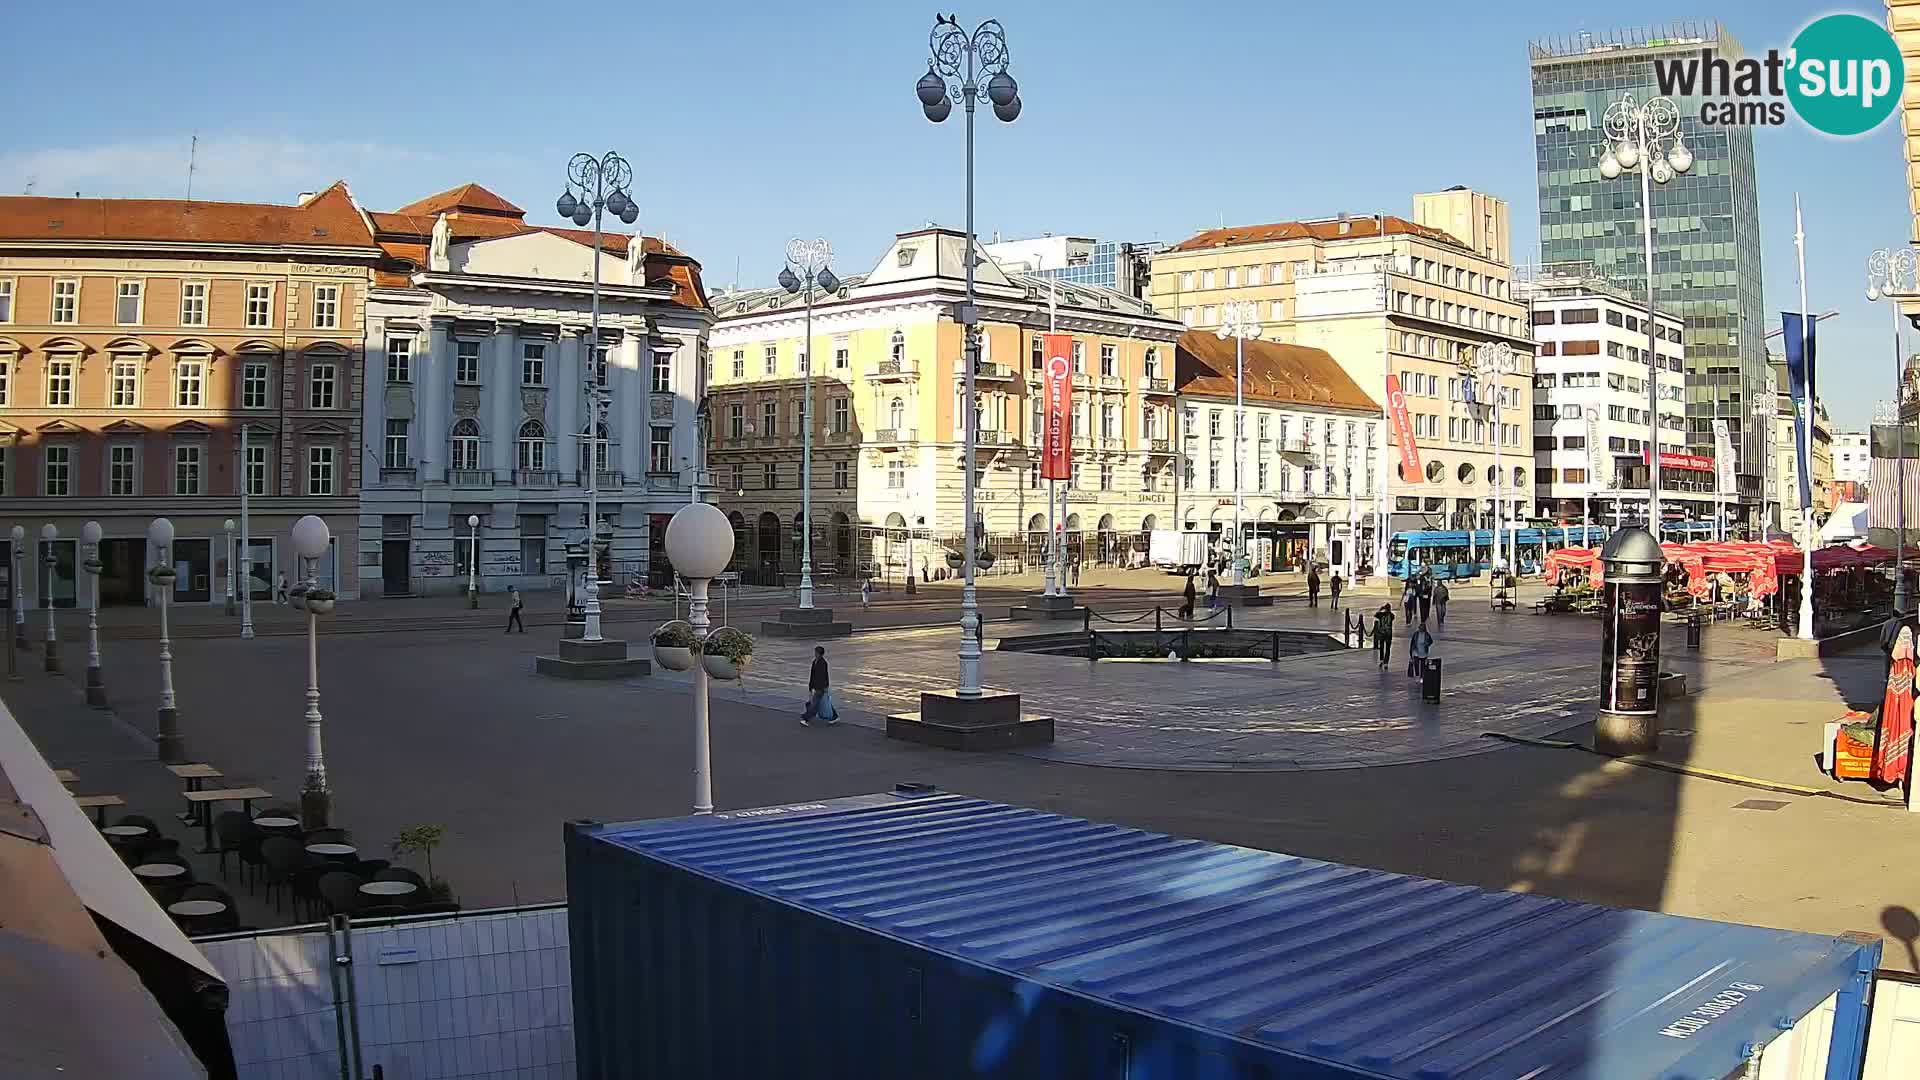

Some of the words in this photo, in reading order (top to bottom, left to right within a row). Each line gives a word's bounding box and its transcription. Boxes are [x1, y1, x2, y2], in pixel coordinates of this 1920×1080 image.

[1047, 356, 1069, 408] Queer
[1049, 410, 1064, 456] Zagreb
[1692, 990, 1747, 1018] 300629
